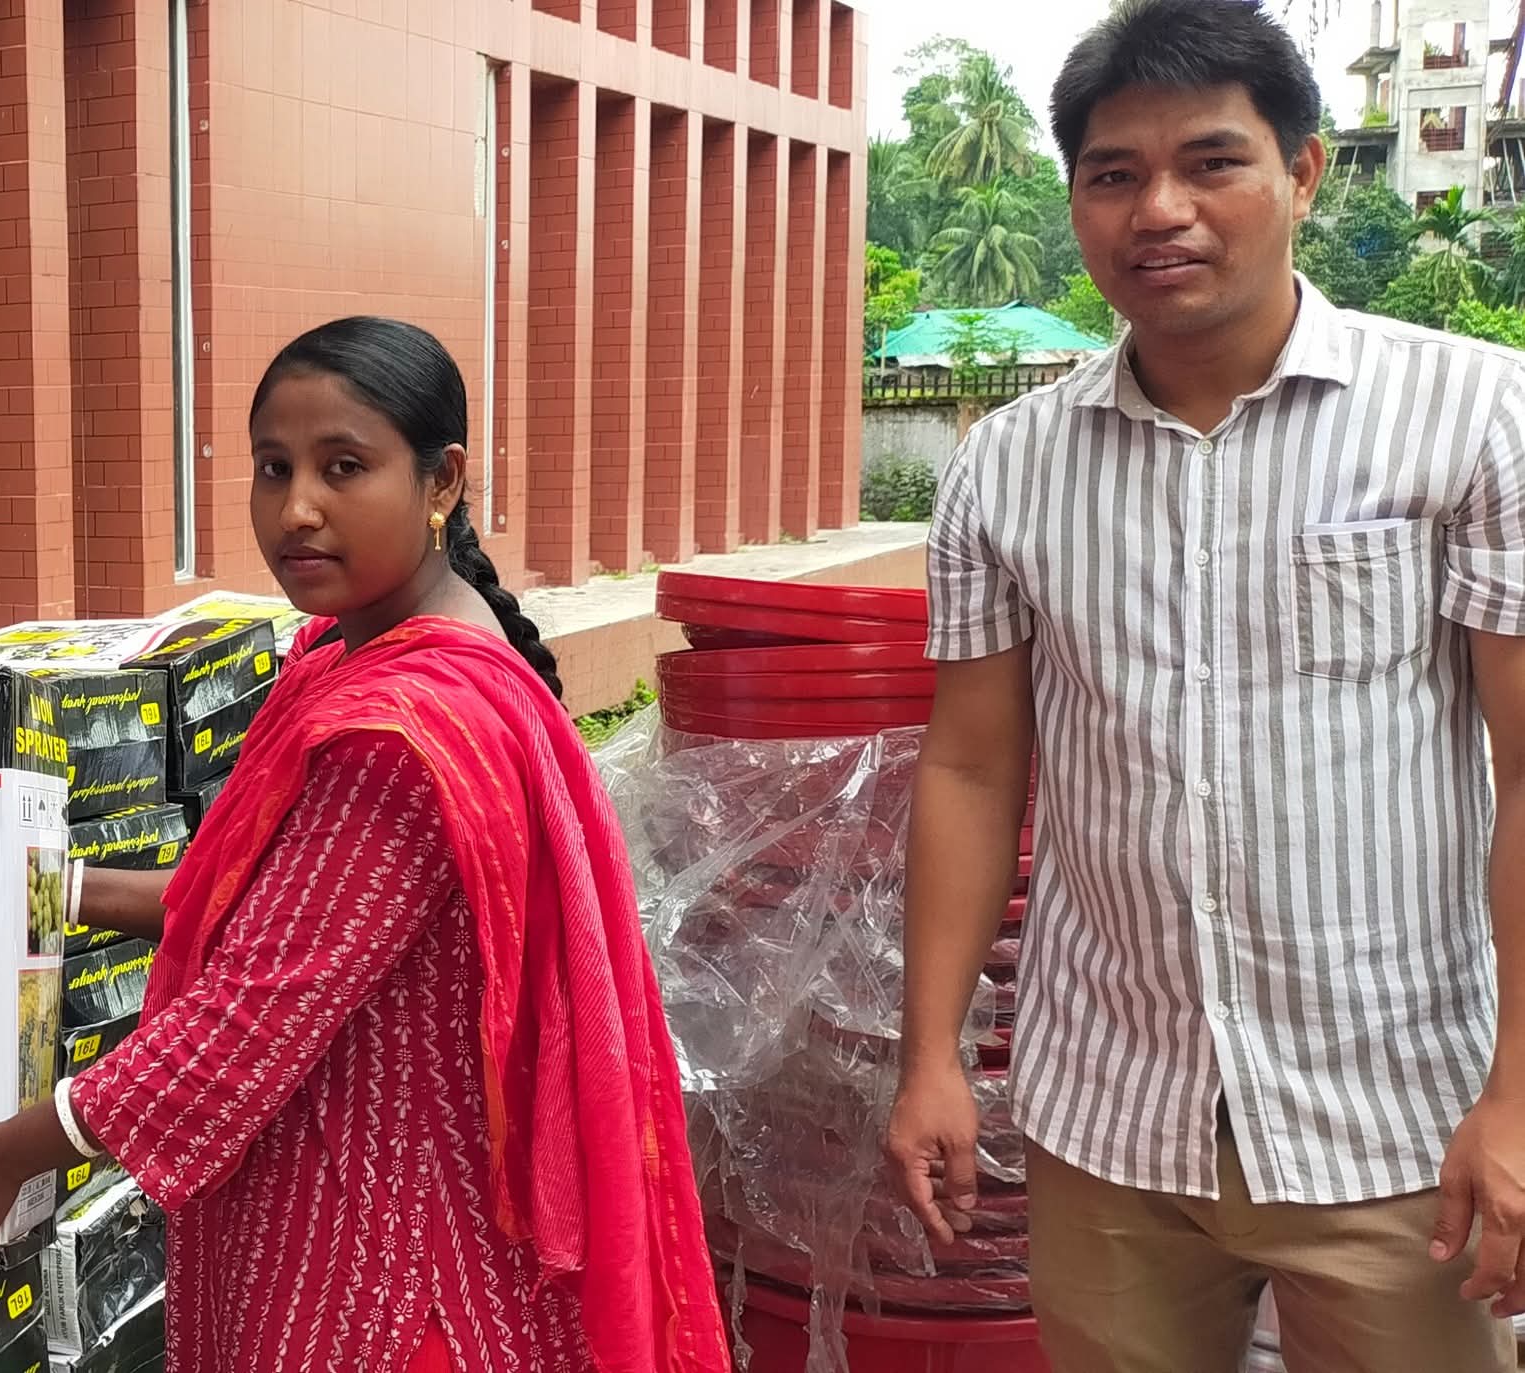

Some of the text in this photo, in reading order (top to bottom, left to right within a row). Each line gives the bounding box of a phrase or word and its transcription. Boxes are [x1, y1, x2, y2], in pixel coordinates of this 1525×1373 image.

[30, 693, 54, 727] LION
[61, 687, 142, 715] professional spray
[15, 726, 68, 763] SPRAYER
[68, 773, 126, 805] professional
[126, 775, 159, 794] sprayer
[99, 827, 160, 862] professional
[68, 963, 108, 990] sprayer
[77, 1042, 96, 1057] 16L
[69, 1167, 89, 1186] 16L
[10, 1290, 30, 1312] 16L
